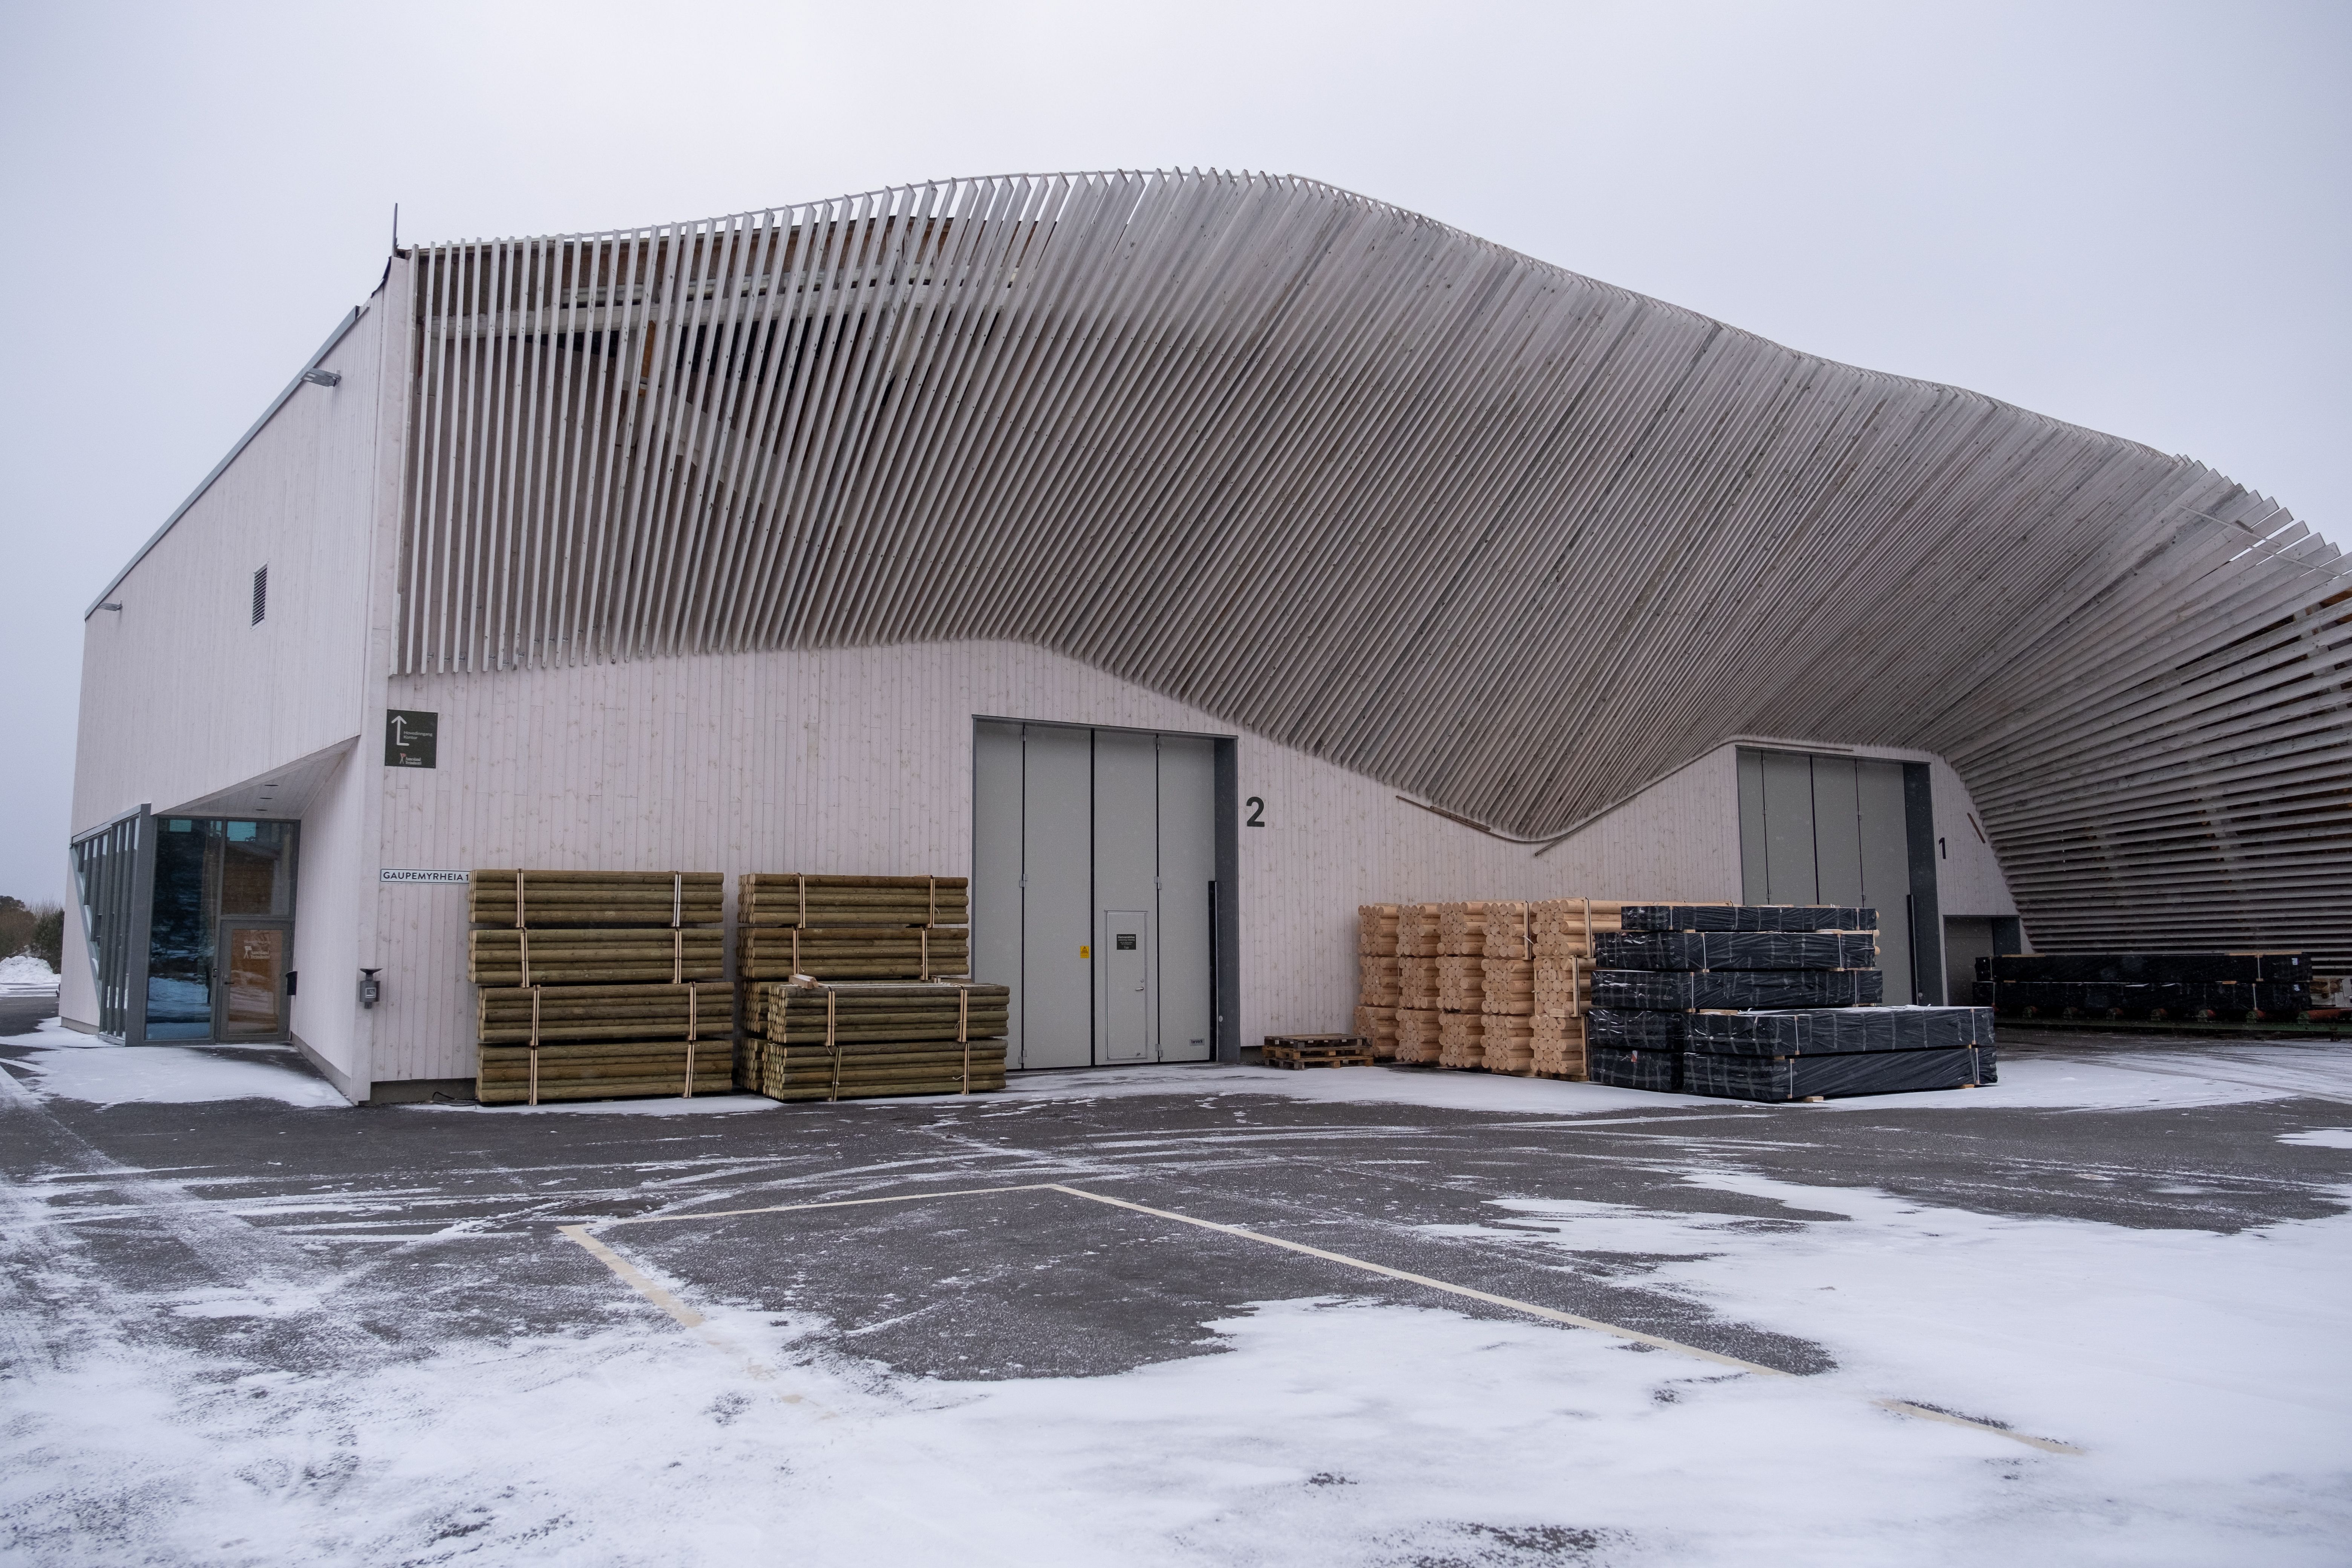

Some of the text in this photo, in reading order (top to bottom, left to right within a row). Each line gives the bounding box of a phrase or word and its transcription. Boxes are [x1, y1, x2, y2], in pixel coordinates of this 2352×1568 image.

[1246, 796, 1265, 827] 2
[1939, 837, 1946, 859] 1
[383, 871, 463, 881] GAUPEMYRHEIA
